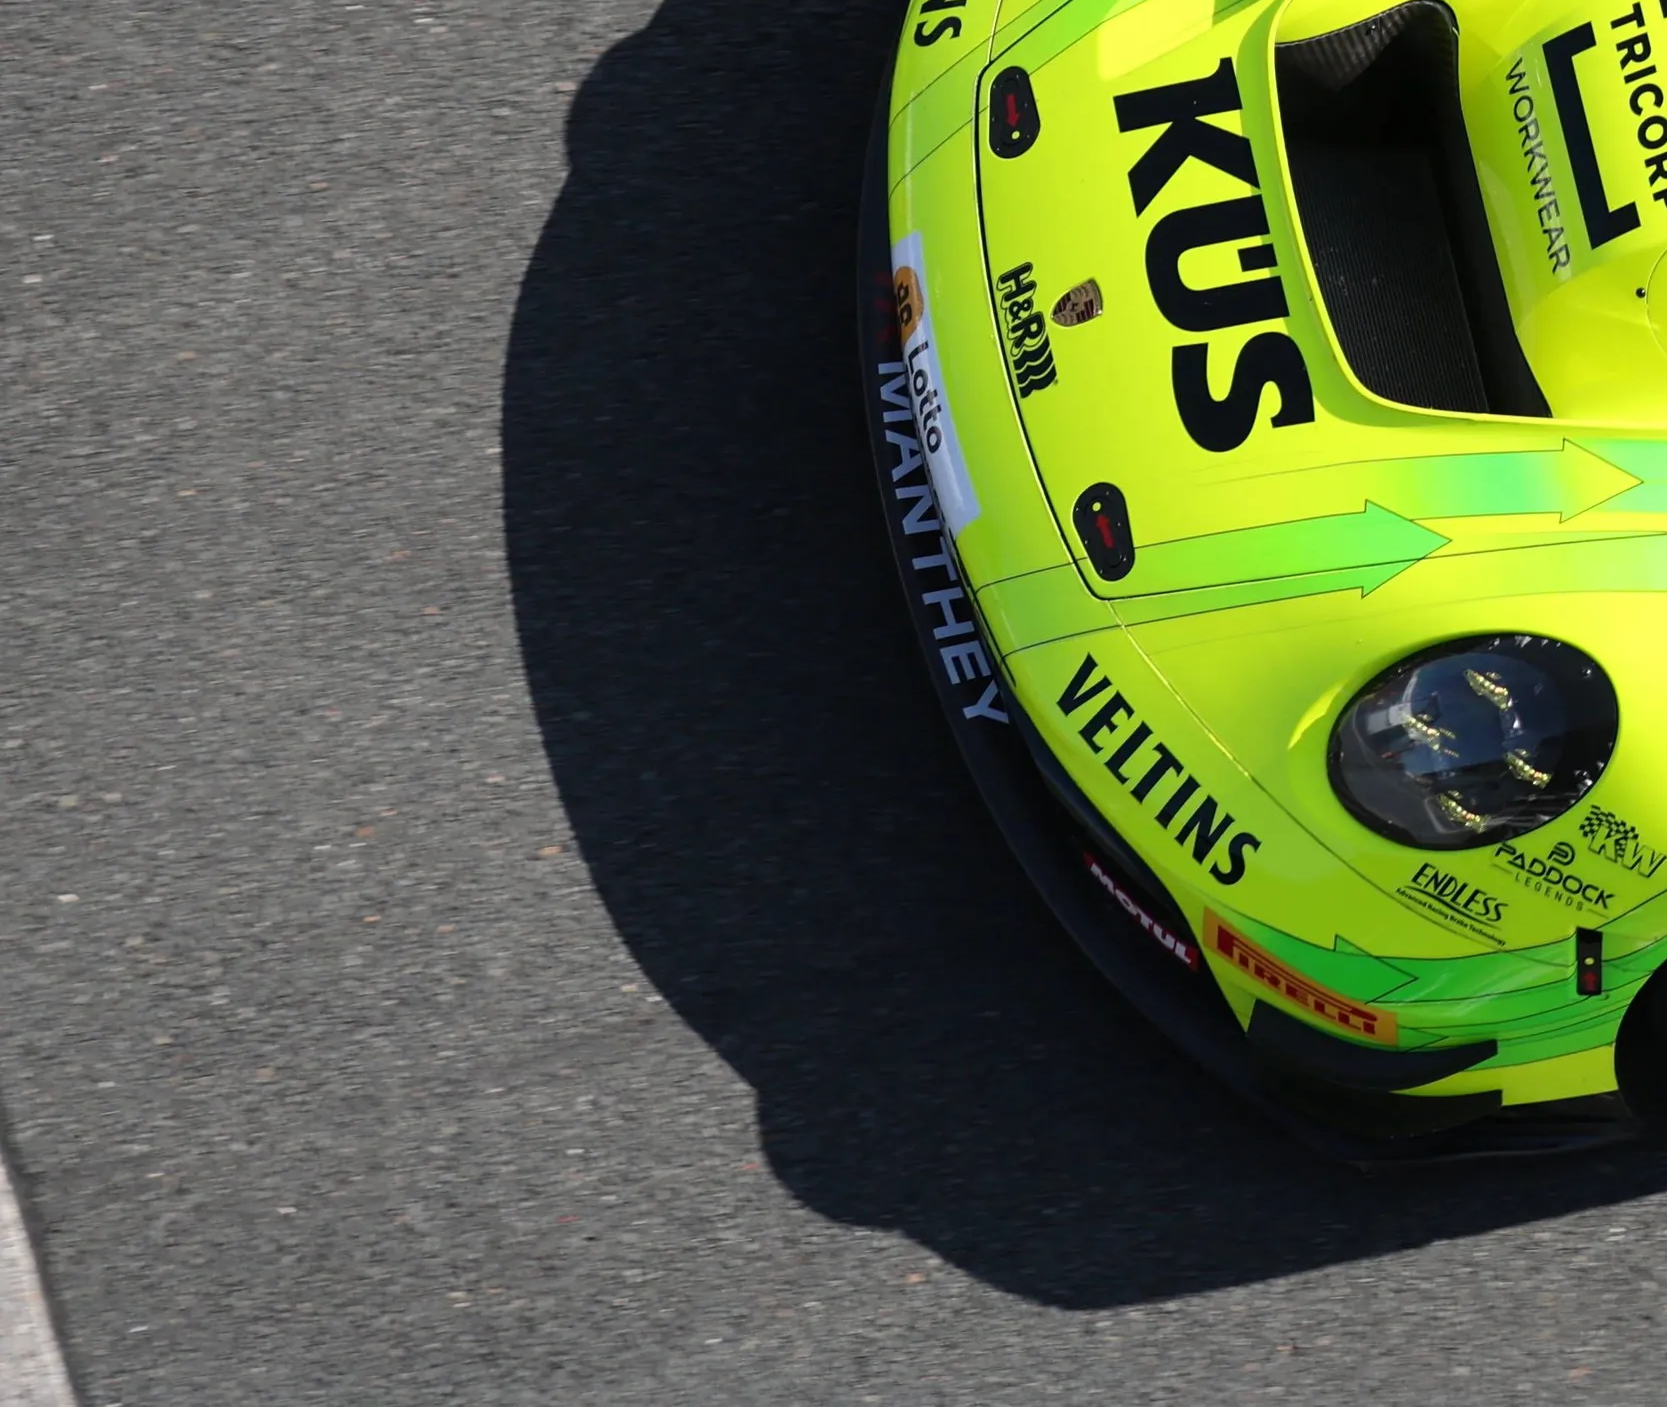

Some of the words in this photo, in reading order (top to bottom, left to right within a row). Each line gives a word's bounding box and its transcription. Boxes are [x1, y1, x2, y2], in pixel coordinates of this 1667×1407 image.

[1505, 57, 1570, 274] WORKWEAR
[1113, 56, 1315, 452] KÜS
[996, 262, 1047, 357] H&R
[908, 341, 942, 454] Lotto
[878, 361, 1009, 724] MANTHEY
[1055, 652, 1262, 886] VELTINS
[1090, 863, 1192, 964] MOTUL
[1410, 862, 1509, 923] ENDLESS
[1494, 843, 1615, 911] PADDOCK
[1515, 871, 1584, 912] LEGENDS
[1217, 925, 1378, 1035] PIRELLI
